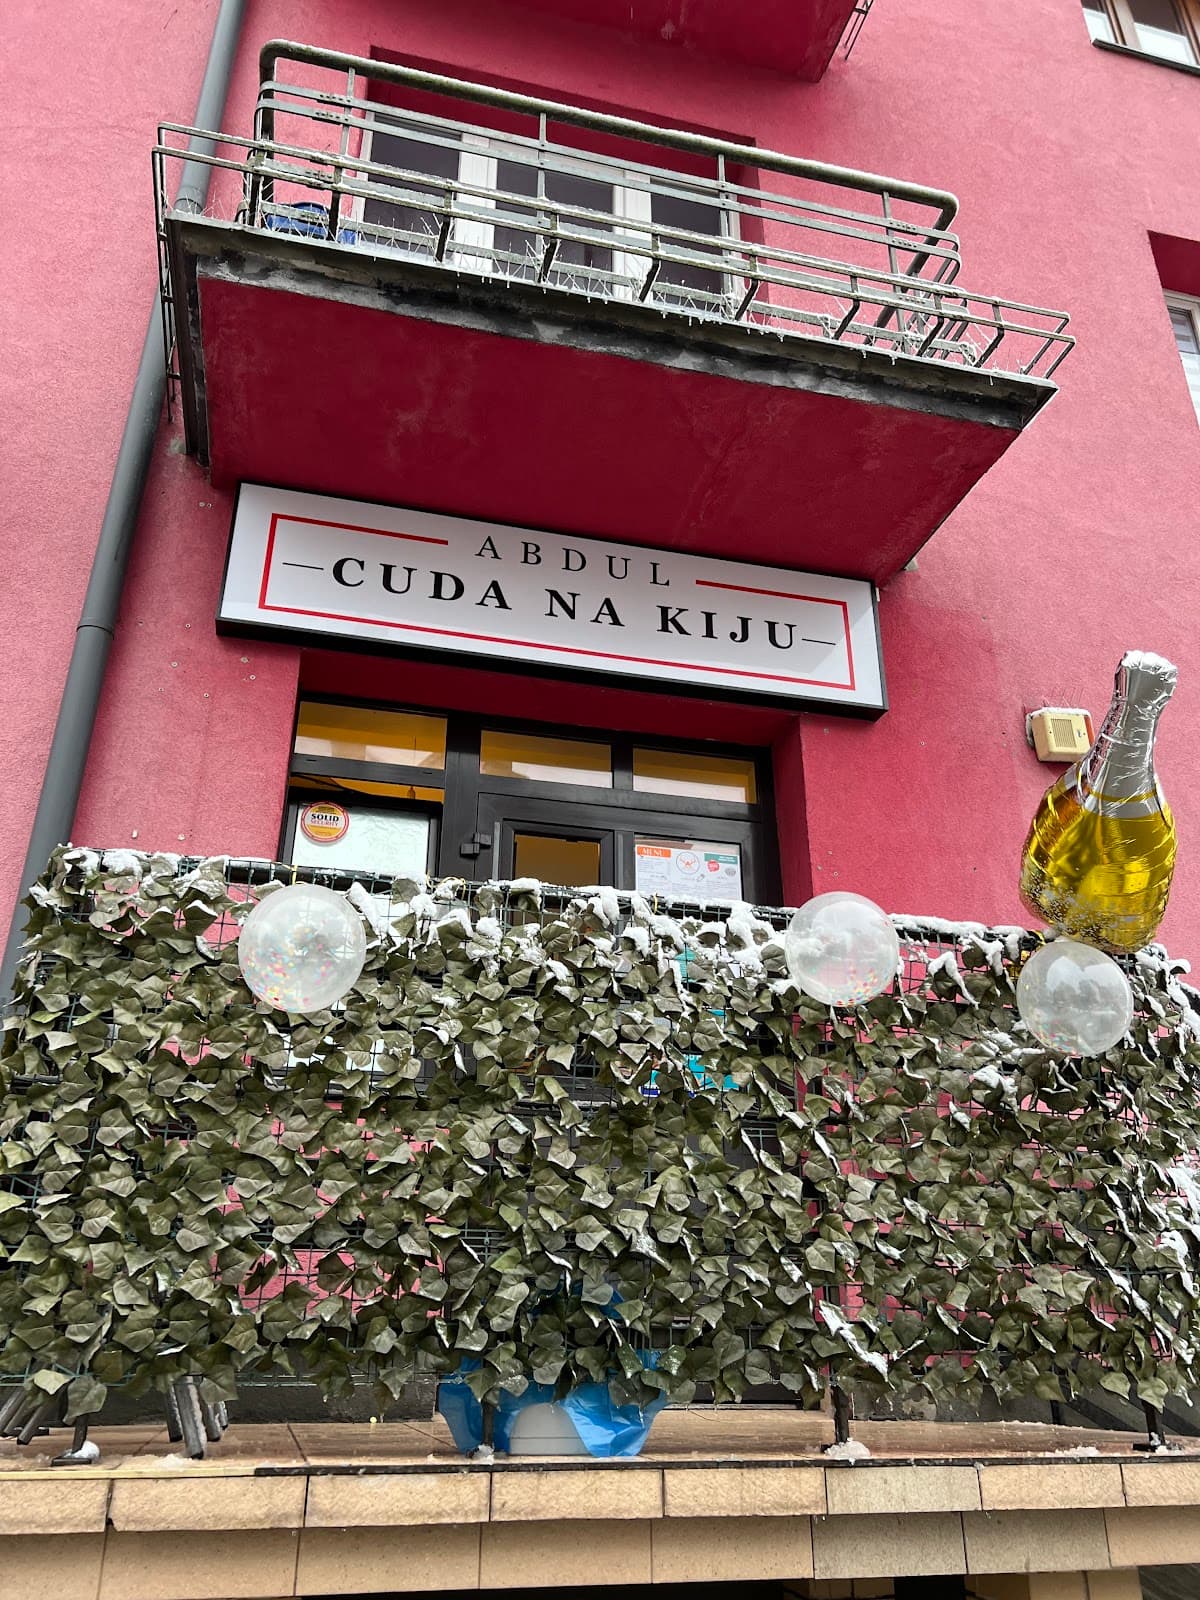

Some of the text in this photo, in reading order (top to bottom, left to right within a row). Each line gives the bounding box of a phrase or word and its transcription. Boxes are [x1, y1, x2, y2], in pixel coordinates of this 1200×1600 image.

[475, 536, 670, 587] ABDUL
[332, 557, 798, 650] CUDA NA KIJU
[311, 813, 339, 822] SOLID
